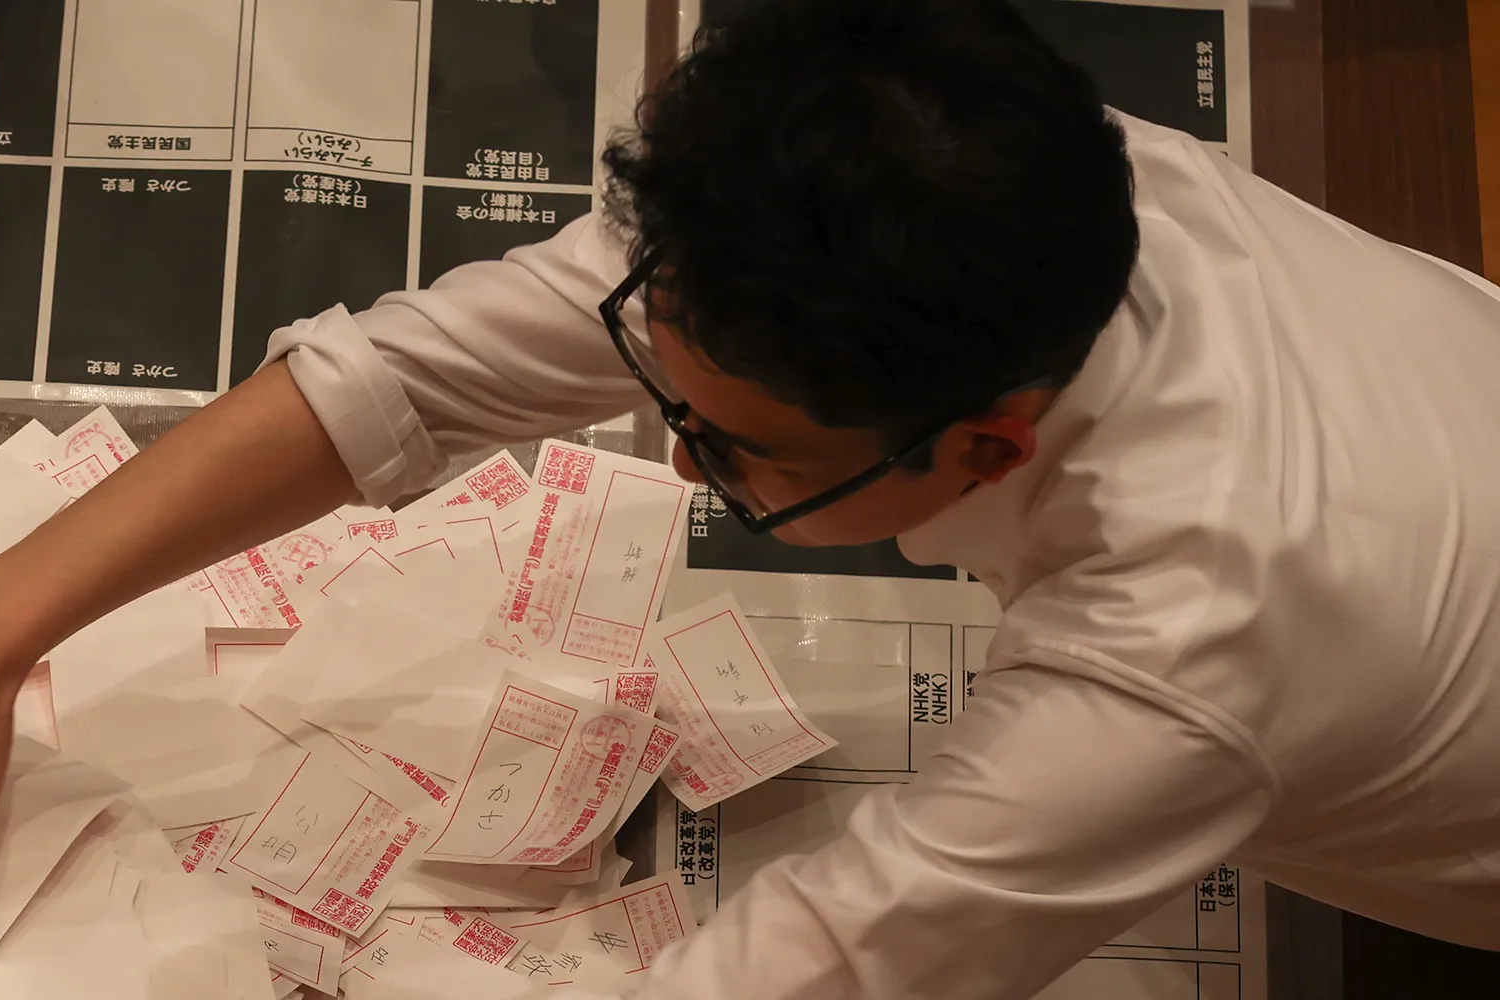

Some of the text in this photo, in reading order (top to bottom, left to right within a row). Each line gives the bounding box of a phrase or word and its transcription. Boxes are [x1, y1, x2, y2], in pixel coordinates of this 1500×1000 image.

[1196, 40, 1214, 108] 立憲民主党
[107, 135, 190, 149] 国民民主党
[297, 132, 360, 151] （みらい）
[284, 147, 372, 166] チームみらい
[474, 148, 543, 164] （自民党）
[465, 163, 548, 180] 自由民主党
[101, 176, 190, 191] つかさ 隆史
[291, 173, 360, 192] （共産党）
[284, 188, 367, 207] 日本共産党
[480, 192, 532, 207] （維新）
[455, 205, 555, 223] 日本維新の会
[86, 359, 177, 378] つかさ 隆史
[912, 672, 930, 722] NHK党
[930, 672, 949, 724] （NHK）
[467, 755, 530, 834] つかさ
[679, 810, 695, 885] 日本改革党
[698, 818, 714, 879] （改革党）
[1218, 863, 1234, 906] （保守
